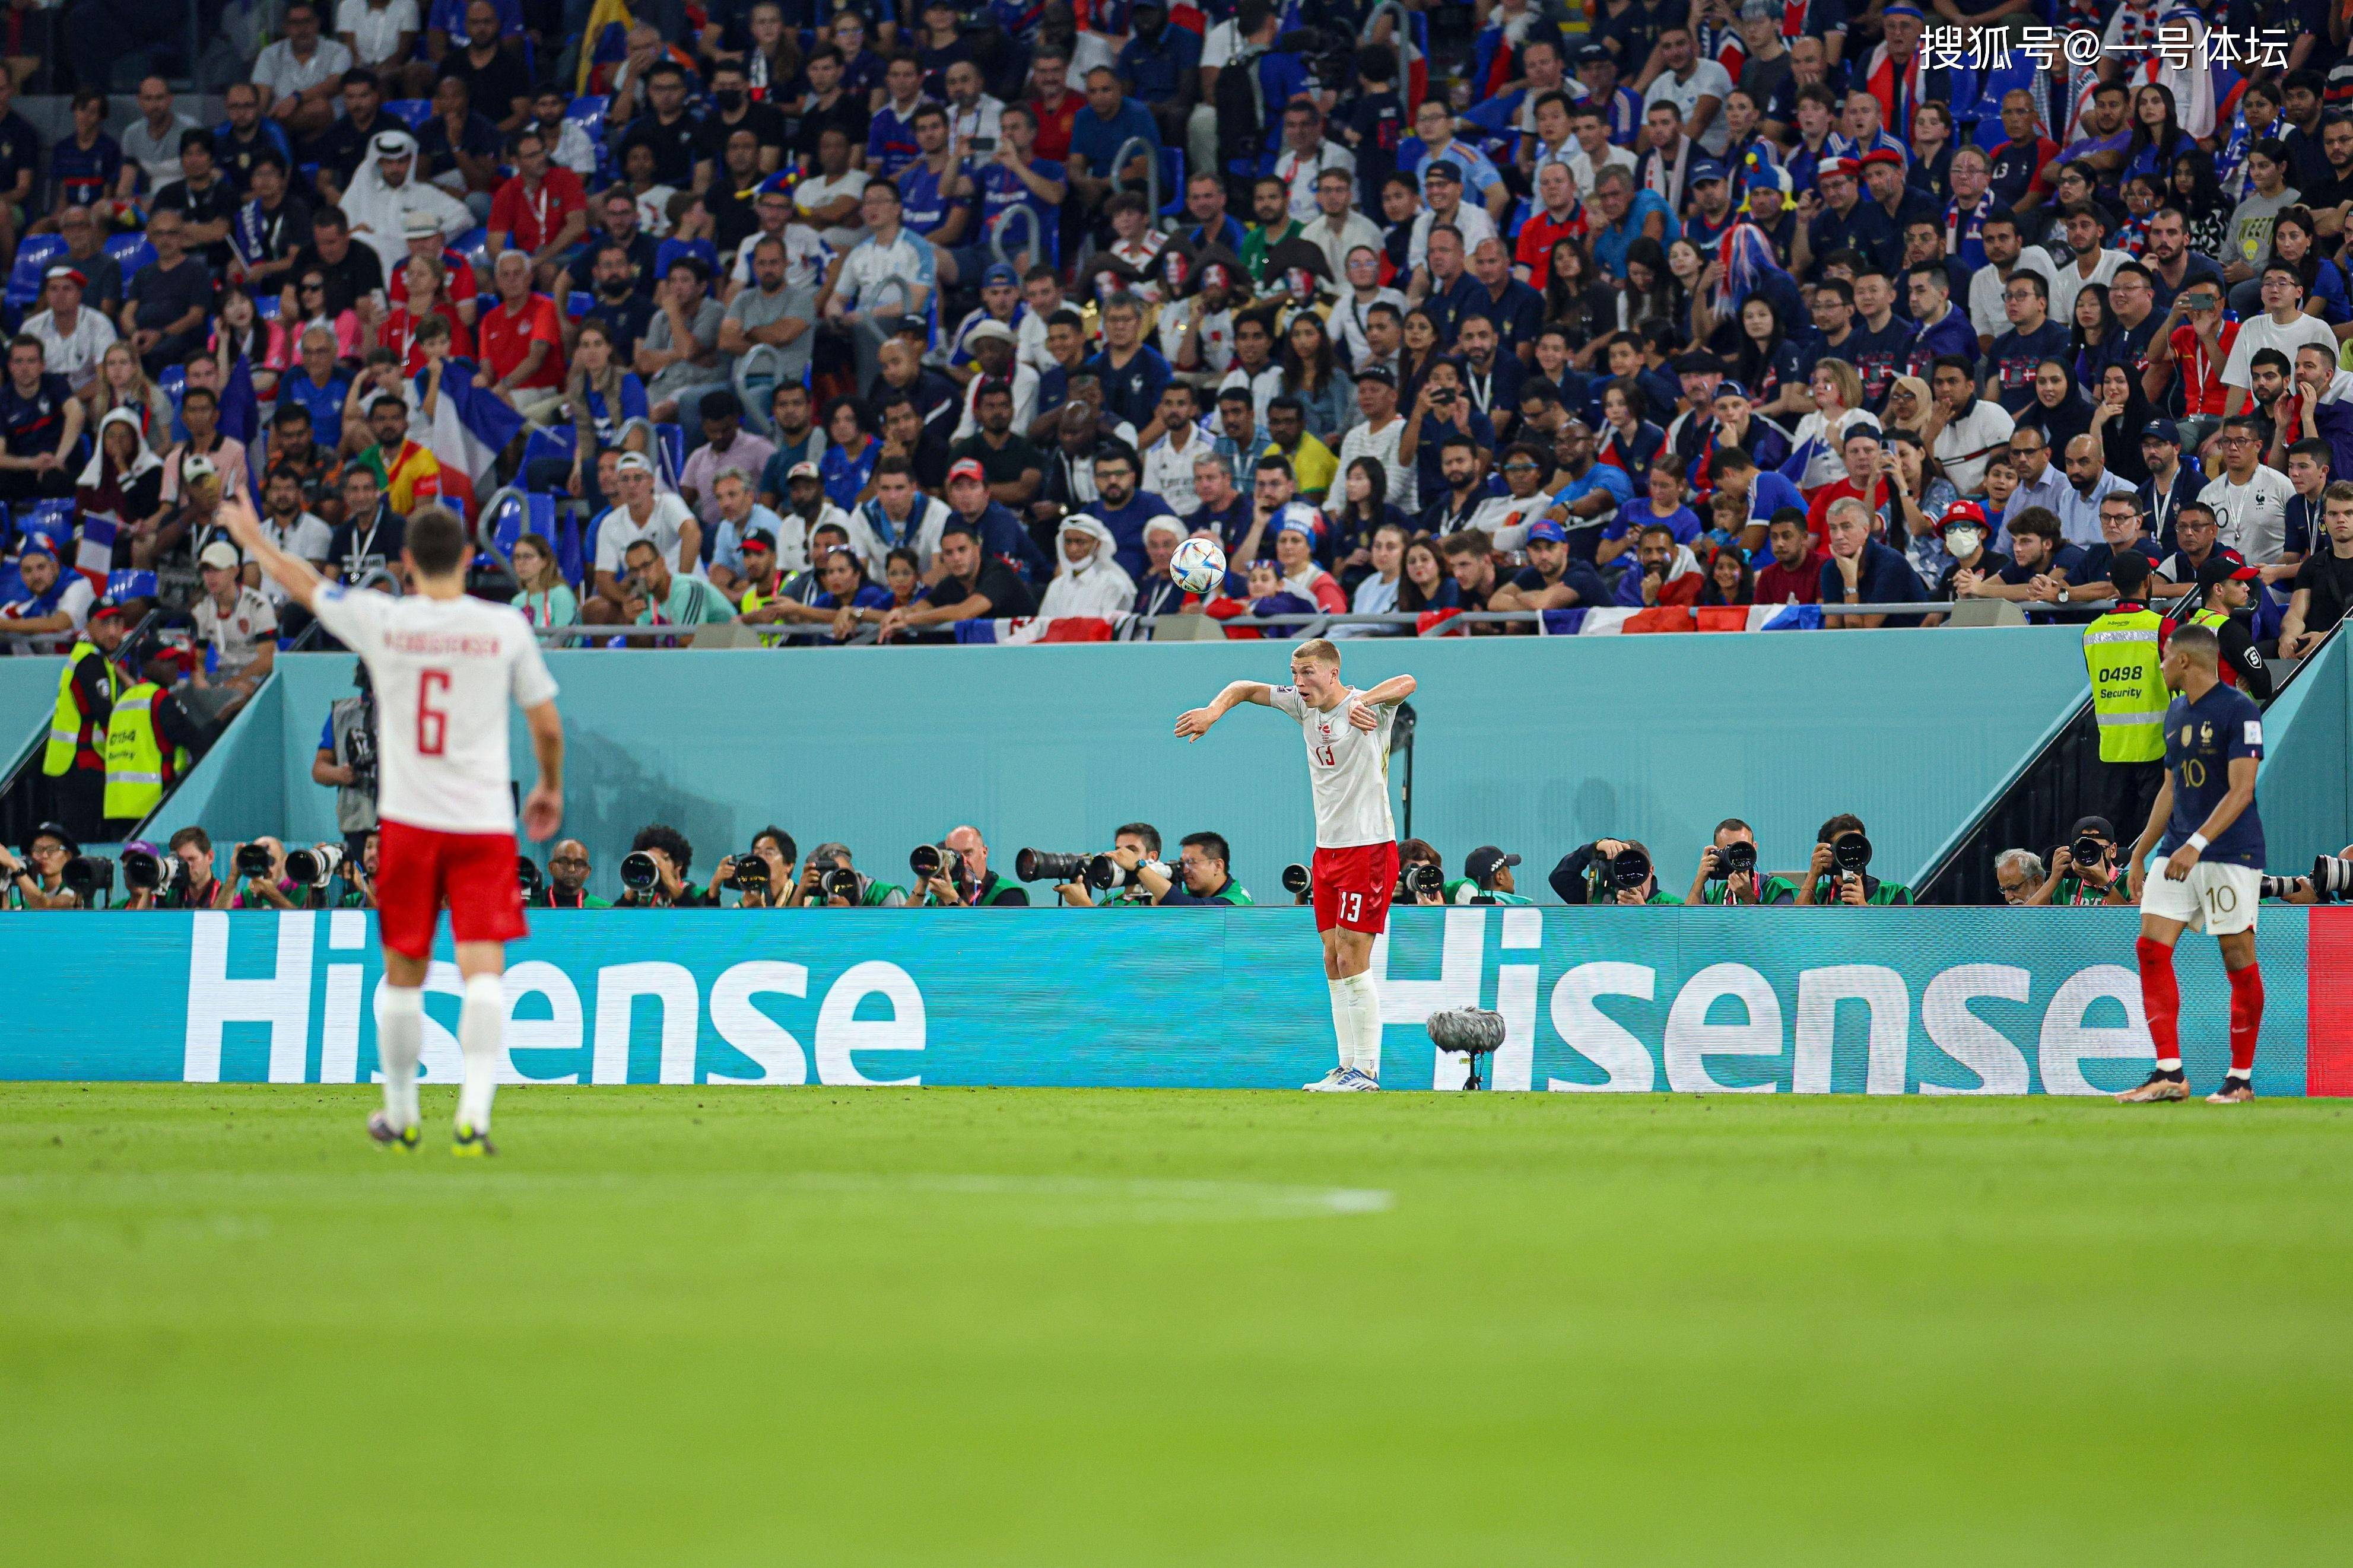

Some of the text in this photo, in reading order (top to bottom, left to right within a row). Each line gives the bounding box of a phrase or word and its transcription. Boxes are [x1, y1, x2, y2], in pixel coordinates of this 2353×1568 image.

[2099, 666, 2143, 683] 0498
[2100, 686, 2142, 699] Security
[418, 670, 450, 755] 6
[2180, 759, 2206, 788] 10
[1339, 892, 1363, 923] 13
[2205, 886, 2237, 914] 10
[183, 909, 926, 1086] Hisense
[1373, 908, 2157, 1095] Hisense
